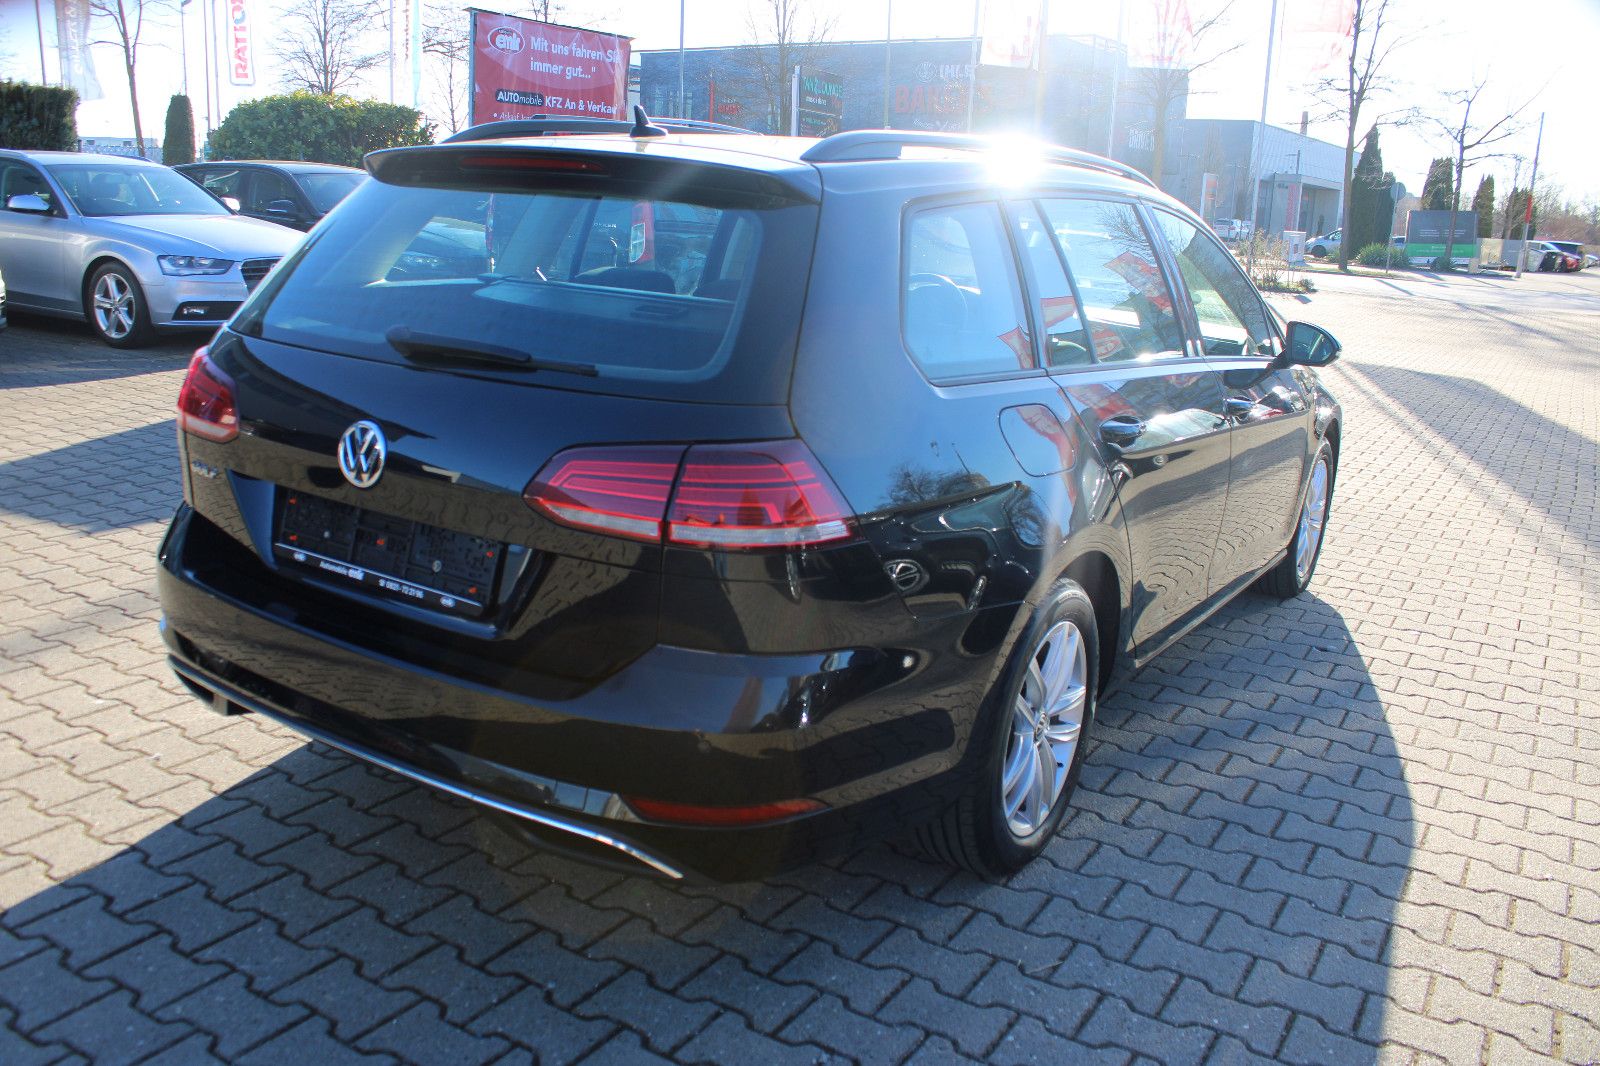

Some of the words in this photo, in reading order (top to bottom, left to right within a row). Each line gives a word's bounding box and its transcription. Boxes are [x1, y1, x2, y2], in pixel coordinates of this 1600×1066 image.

[531, 36, 548, 52] Mit
[552, 43, 569, 55] uns
[572, 43, 603, 60] fahren
[531, 57, 563, 74] immer
[497, 91, 542, 105] AUTOmobile
[546, 96, 562, 108] KFZ
[565, 98, 576, 110] An
[578, 99, 585, 111] &
